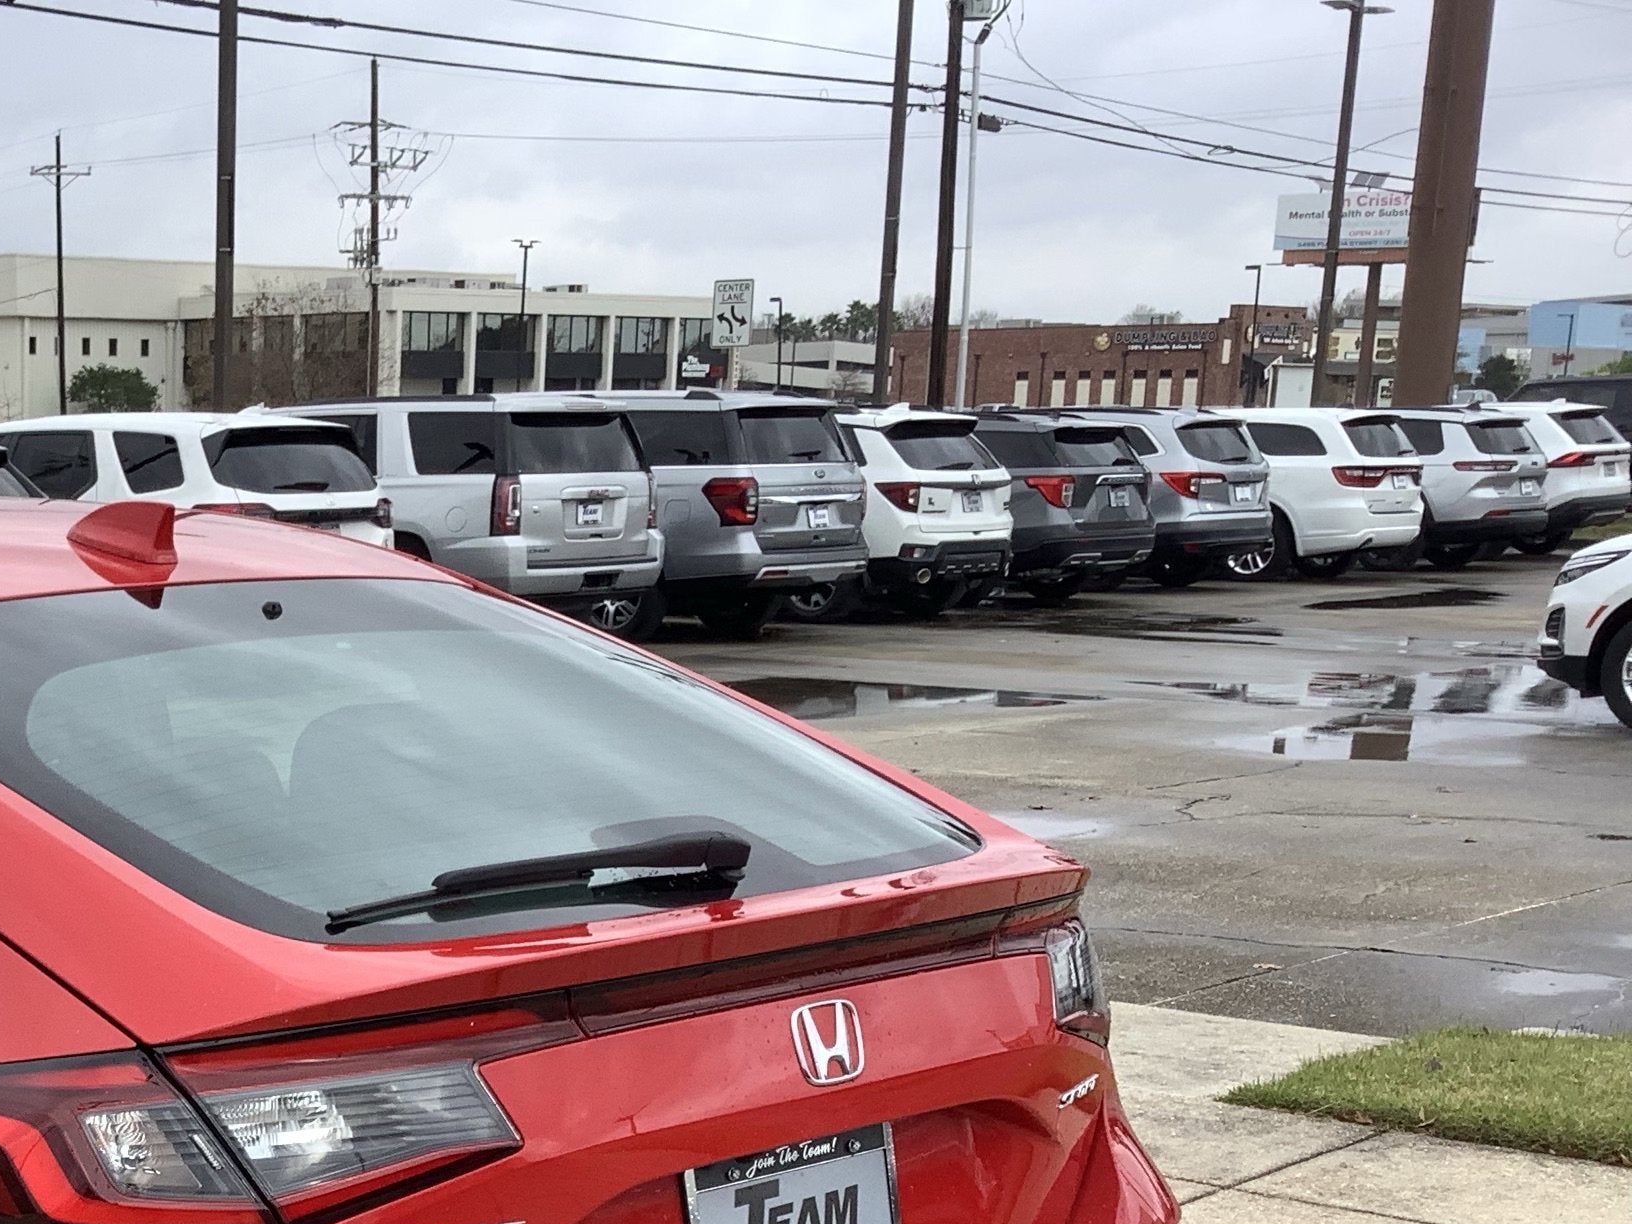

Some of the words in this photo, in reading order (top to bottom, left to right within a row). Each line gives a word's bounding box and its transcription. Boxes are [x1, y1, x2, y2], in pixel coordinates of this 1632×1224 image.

[1289, 210, 1324, 220] Mental
[1365, 210, 1375, 218] or
[717, 283, 750, 292] CENTER
[722, 292, 745, 301] LANE
[718, 335, 742, 344] ONLY
